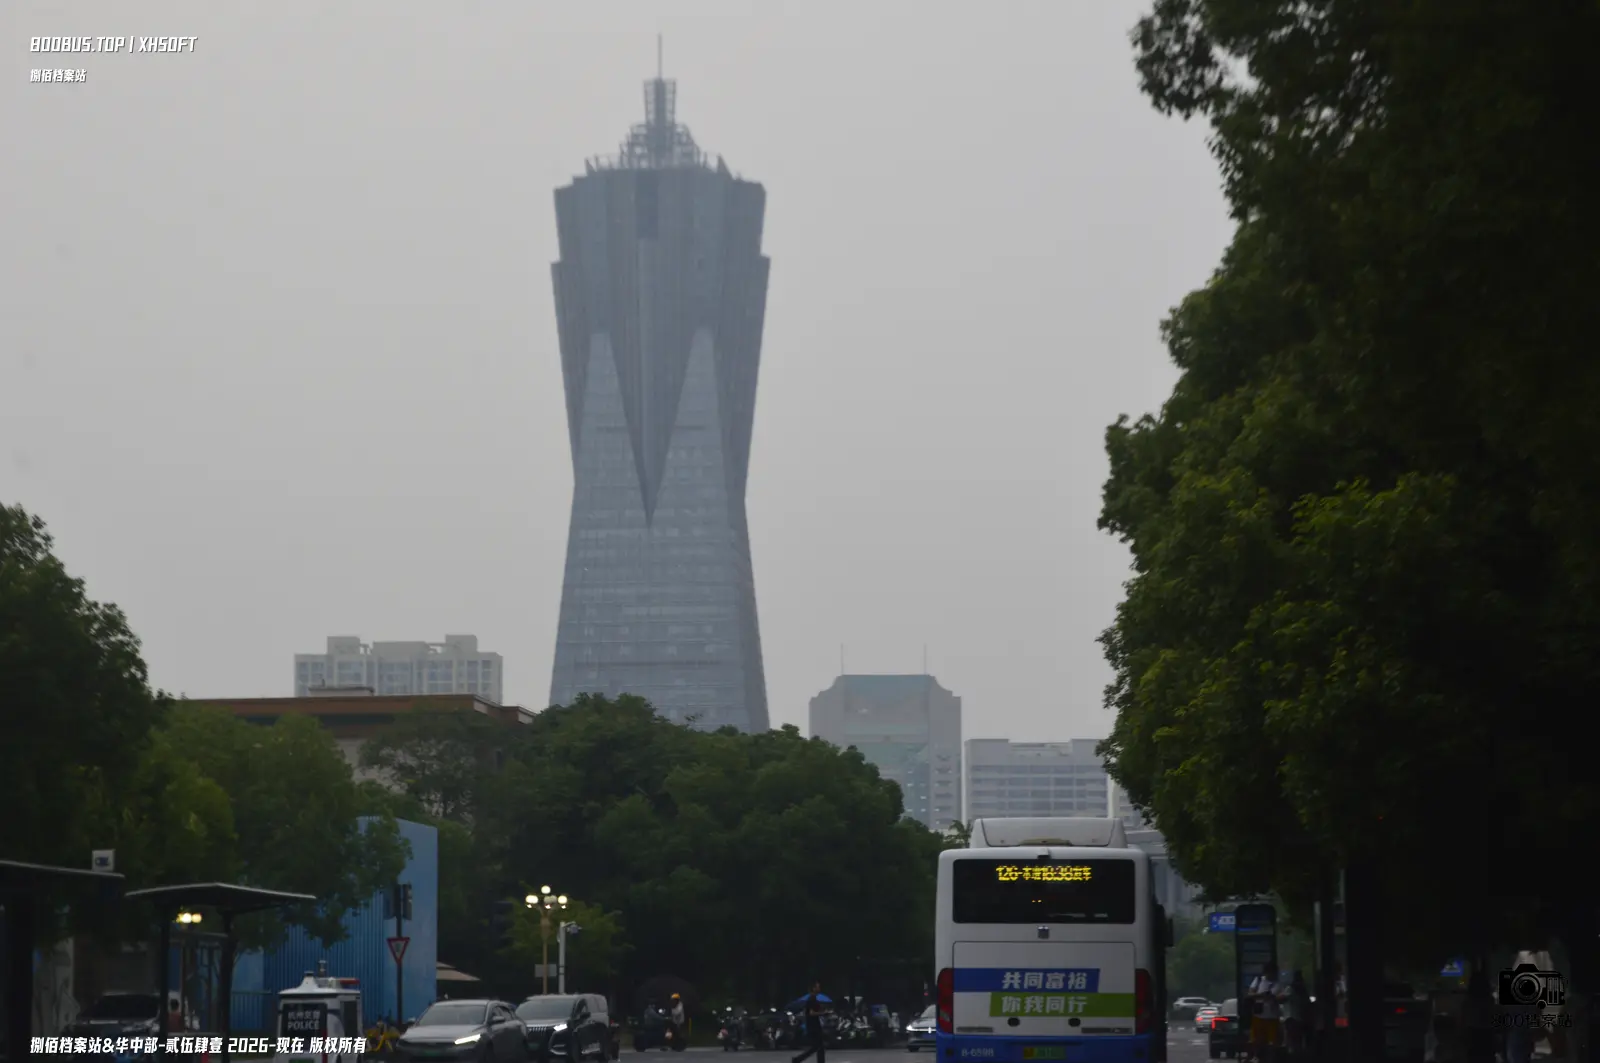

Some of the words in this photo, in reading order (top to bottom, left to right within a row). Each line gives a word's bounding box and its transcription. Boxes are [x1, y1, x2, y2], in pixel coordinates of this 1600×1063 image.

[1001, 971, 1088, 990] 共同富裕
[1001, 995, 1088, 1014] 你我同行
[287, 1020, 320, 1032] POLICE
